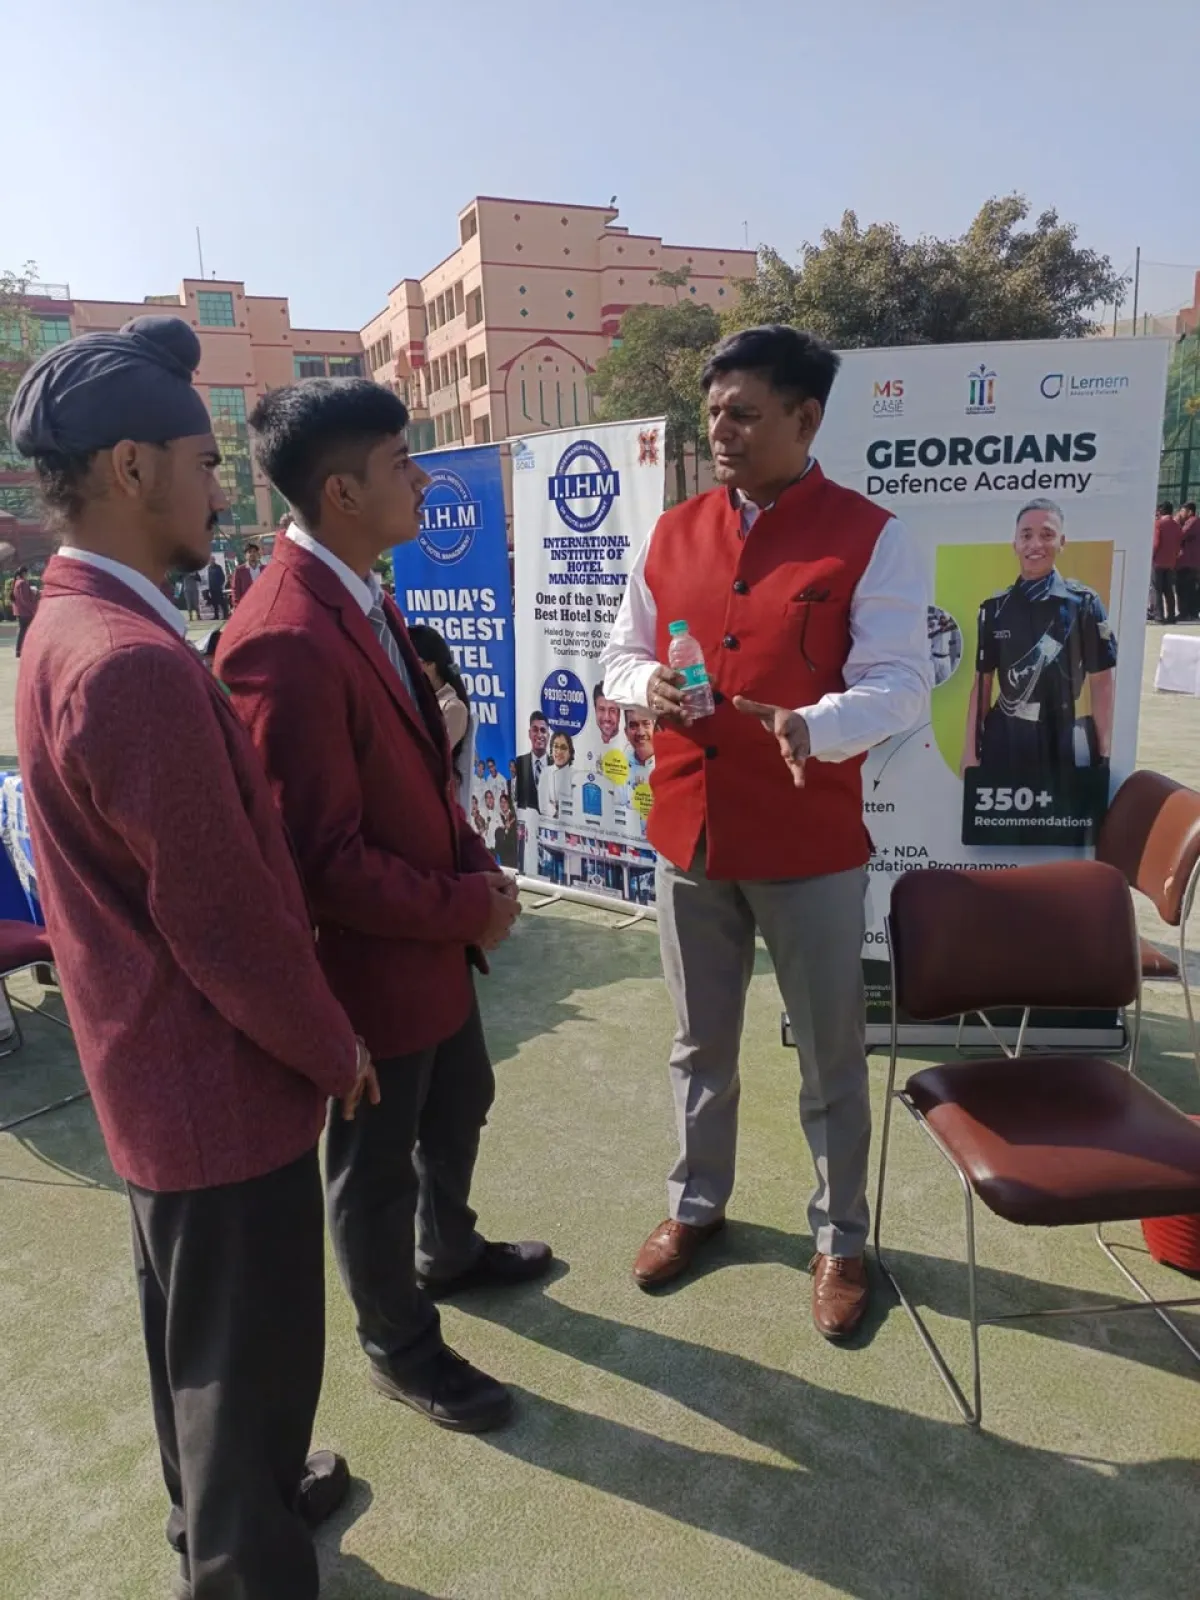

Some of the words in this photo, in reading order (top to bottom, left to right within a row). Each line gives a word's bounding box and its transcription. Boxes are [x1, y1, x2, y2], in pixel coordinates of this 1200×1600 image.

[873, 380, 904, 397] MS
[1071, 375, 1129, 389] Lernern
[866, 432, 1097, 469] GEORGIANS
[554, 474, 615, 498] I.I.H.M
[867, 473, 967, 495] Defence
[974, 469, 1092, 494] Academy
[420, 505, 476, 529] .I.H.M
[544, 535, 630, 549] INTERNATIONAL
[551, 549, 605, 560] INSTITUTE
[607, 549, 625, 560] OF
[567, 561, 603, 572] HOTEL
[549, 574, 628, 585] MANAGEMENT
[406, 588, 496, 612] INDIA'S
[536, 592, 556, 605] One
[559, 592, 572, 605] of
[575, 592, 593, 606] the
[596, 593, 624, 607] Worl
[534, 608, 558, 620] Best
[560, 609, 590, 622] Hotel
[594, 610, 617, 624] Sch
[404, 617, 506, 641] RGEST
[565, 629, 575, 638] by
[591, 630, 602, 638] 60
[450, 645, 493, 669] TEL
[553, 648, 580, 656] Tourism
[460, 673, 505, 697] OOL
[975, 787, 1053, 811] 350+
[864, 802, 895, 813] tten
[974, 816, 1093, 827] Recommendations
[894, 846, 929, 857] NDA
[865, 860, 922, 872] ndation
